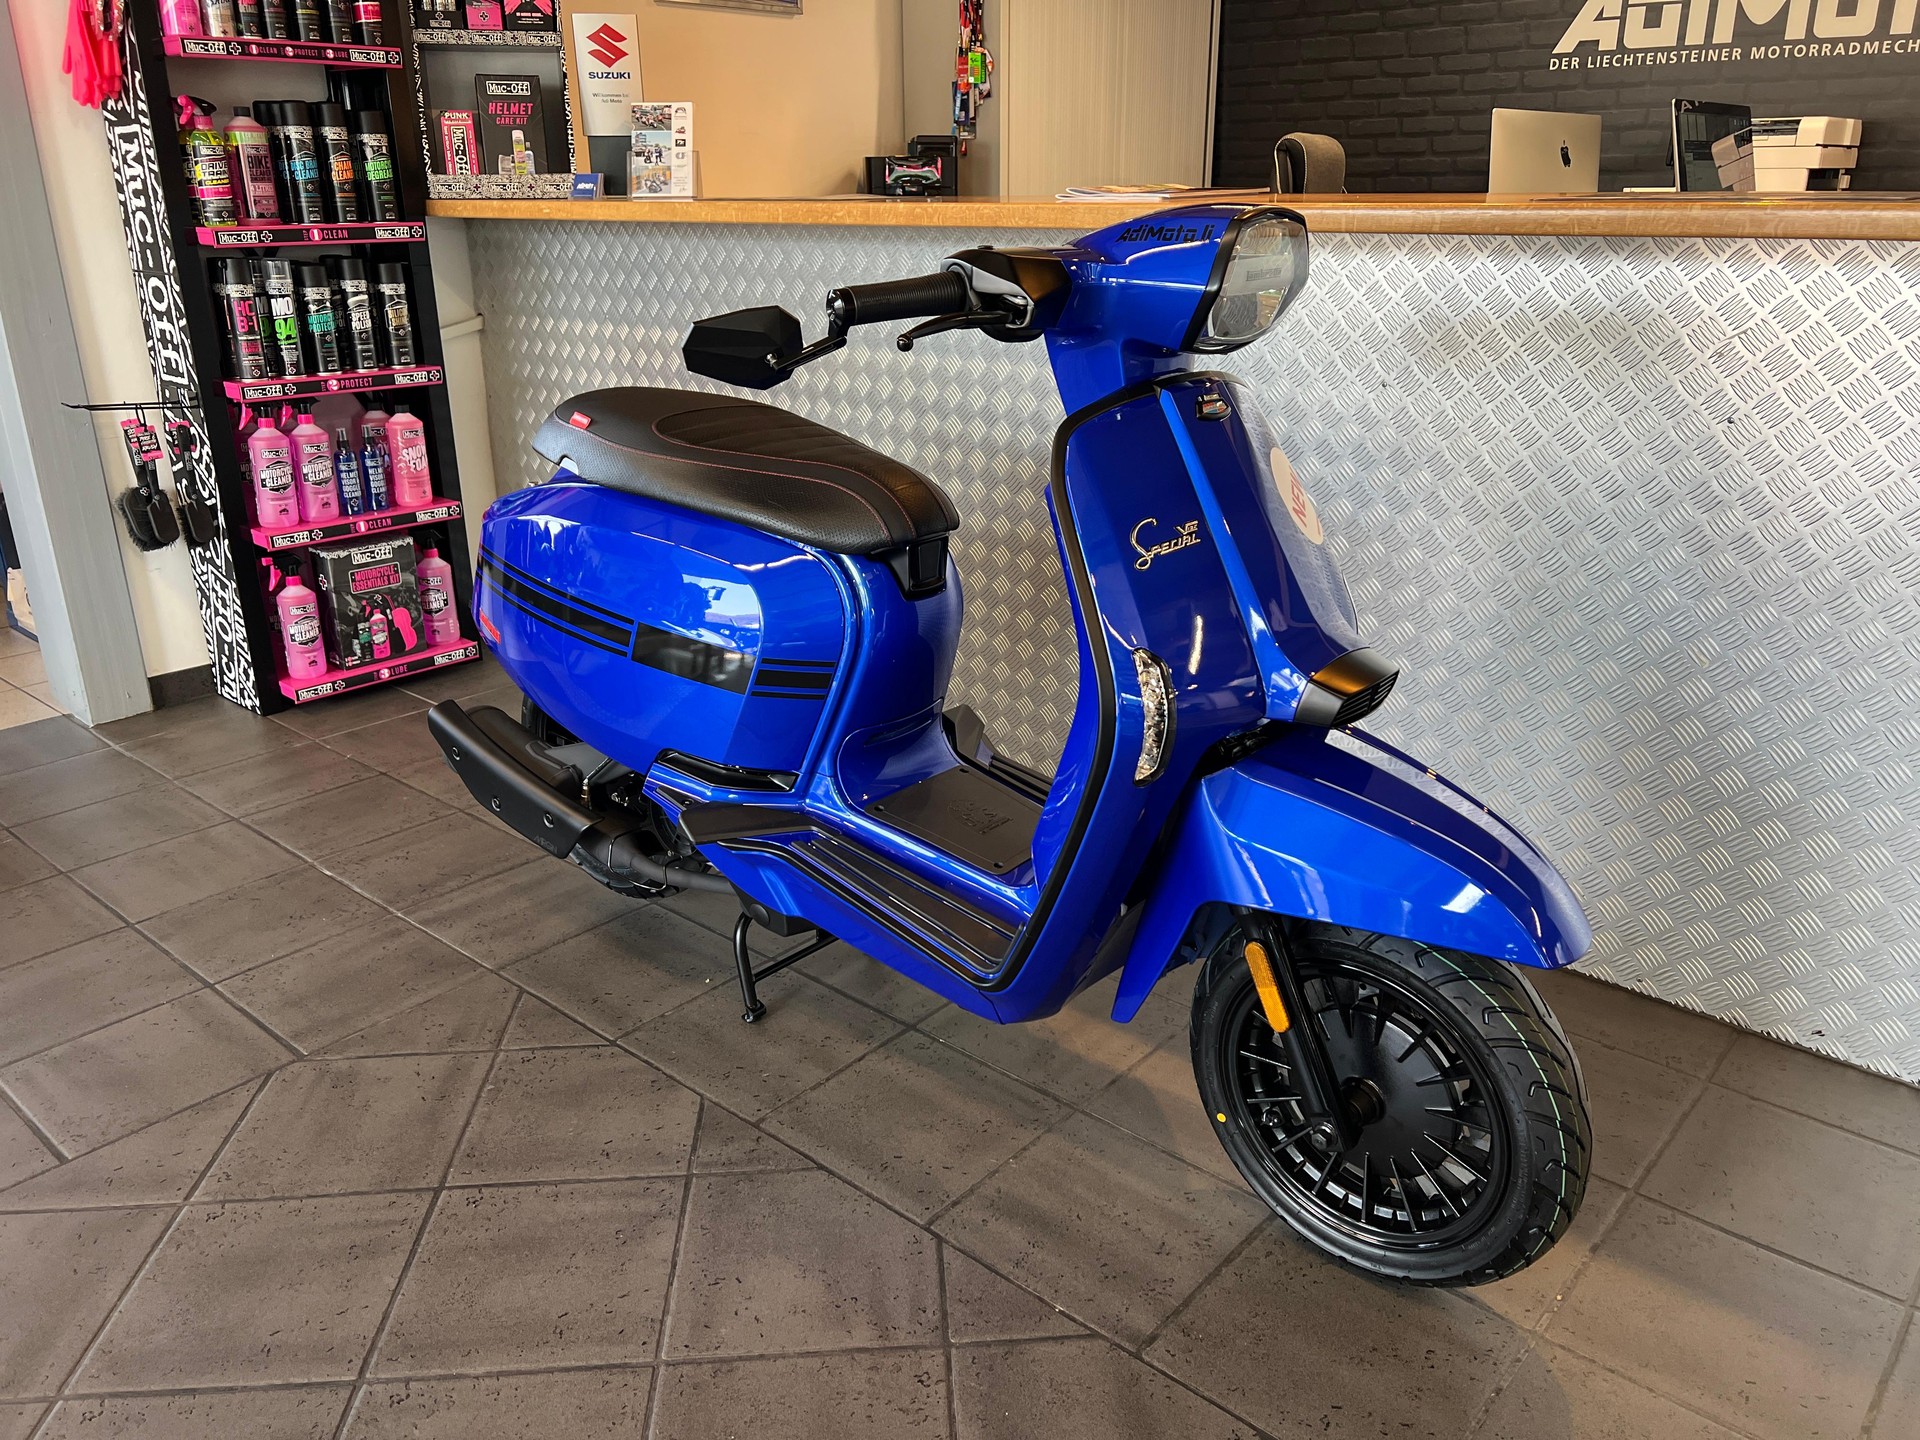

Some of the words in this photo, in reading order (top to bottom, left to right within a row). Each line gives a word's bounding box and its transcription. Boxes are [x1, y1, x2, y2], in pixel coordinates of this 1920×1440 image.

[472, 33, 502, 43] Muc-Off
[186, 41, 225, 53] Muc-Off
[259, 46, 278, 54] CLEAN
[294, 48, 318, 56] PROTECT
[335, 50, 349, 58] LUBE
[351, 50, 385, 62] Muc-Off
[1549, 58, 1580, 71] DER
[1587, 48, 1742, 69] LIECHTENSTEINER
[1750, 39, 1920, 60] MOTORRADMECH
[588, 71, 631, 80] SUZUKI
[488, 82, 529, 94] Muc-Off
[488, 102, 534, 115] HELMET
[495, 117, 514, 125] CARE
[516, 117, 528, 125] KIT
[453, 128, 469, 175] Muc-Off
[247, 156, 270, 169] BIKE
[220, 232, 257, 243] Muc-Off
[323, 229, 349, 239] CLEAN
[375, 227, 409, 238] Muc-Off
[1115, 223, 1215, 243] AdiMoto.li
[270, 296, 294, 316] MO
[274, 317, 298, 340] 94
[246, 385, 281, 398] Muc-Off
[340, 377, 373, 389] PROTECT
[395, 372, 427, 384] Muc-Off
[275, 531, 309, 546] Muc-Off
[368, 518, 392, 529] CLEAN
[416, 507, 448, 522] Muc-Off
[353, 546, 391, 563] Muc-Off
[354, 564, 395, 581] MOTORCYCLE
[352, 575, 389, 592] ESSENTIALS
[390, 573, 400, 584] KIT
[391, 664, 409, 676] LUBE
[433, 649, 465, 666] Muc-Off
[300, 683, 333, 700] Muc-Off
